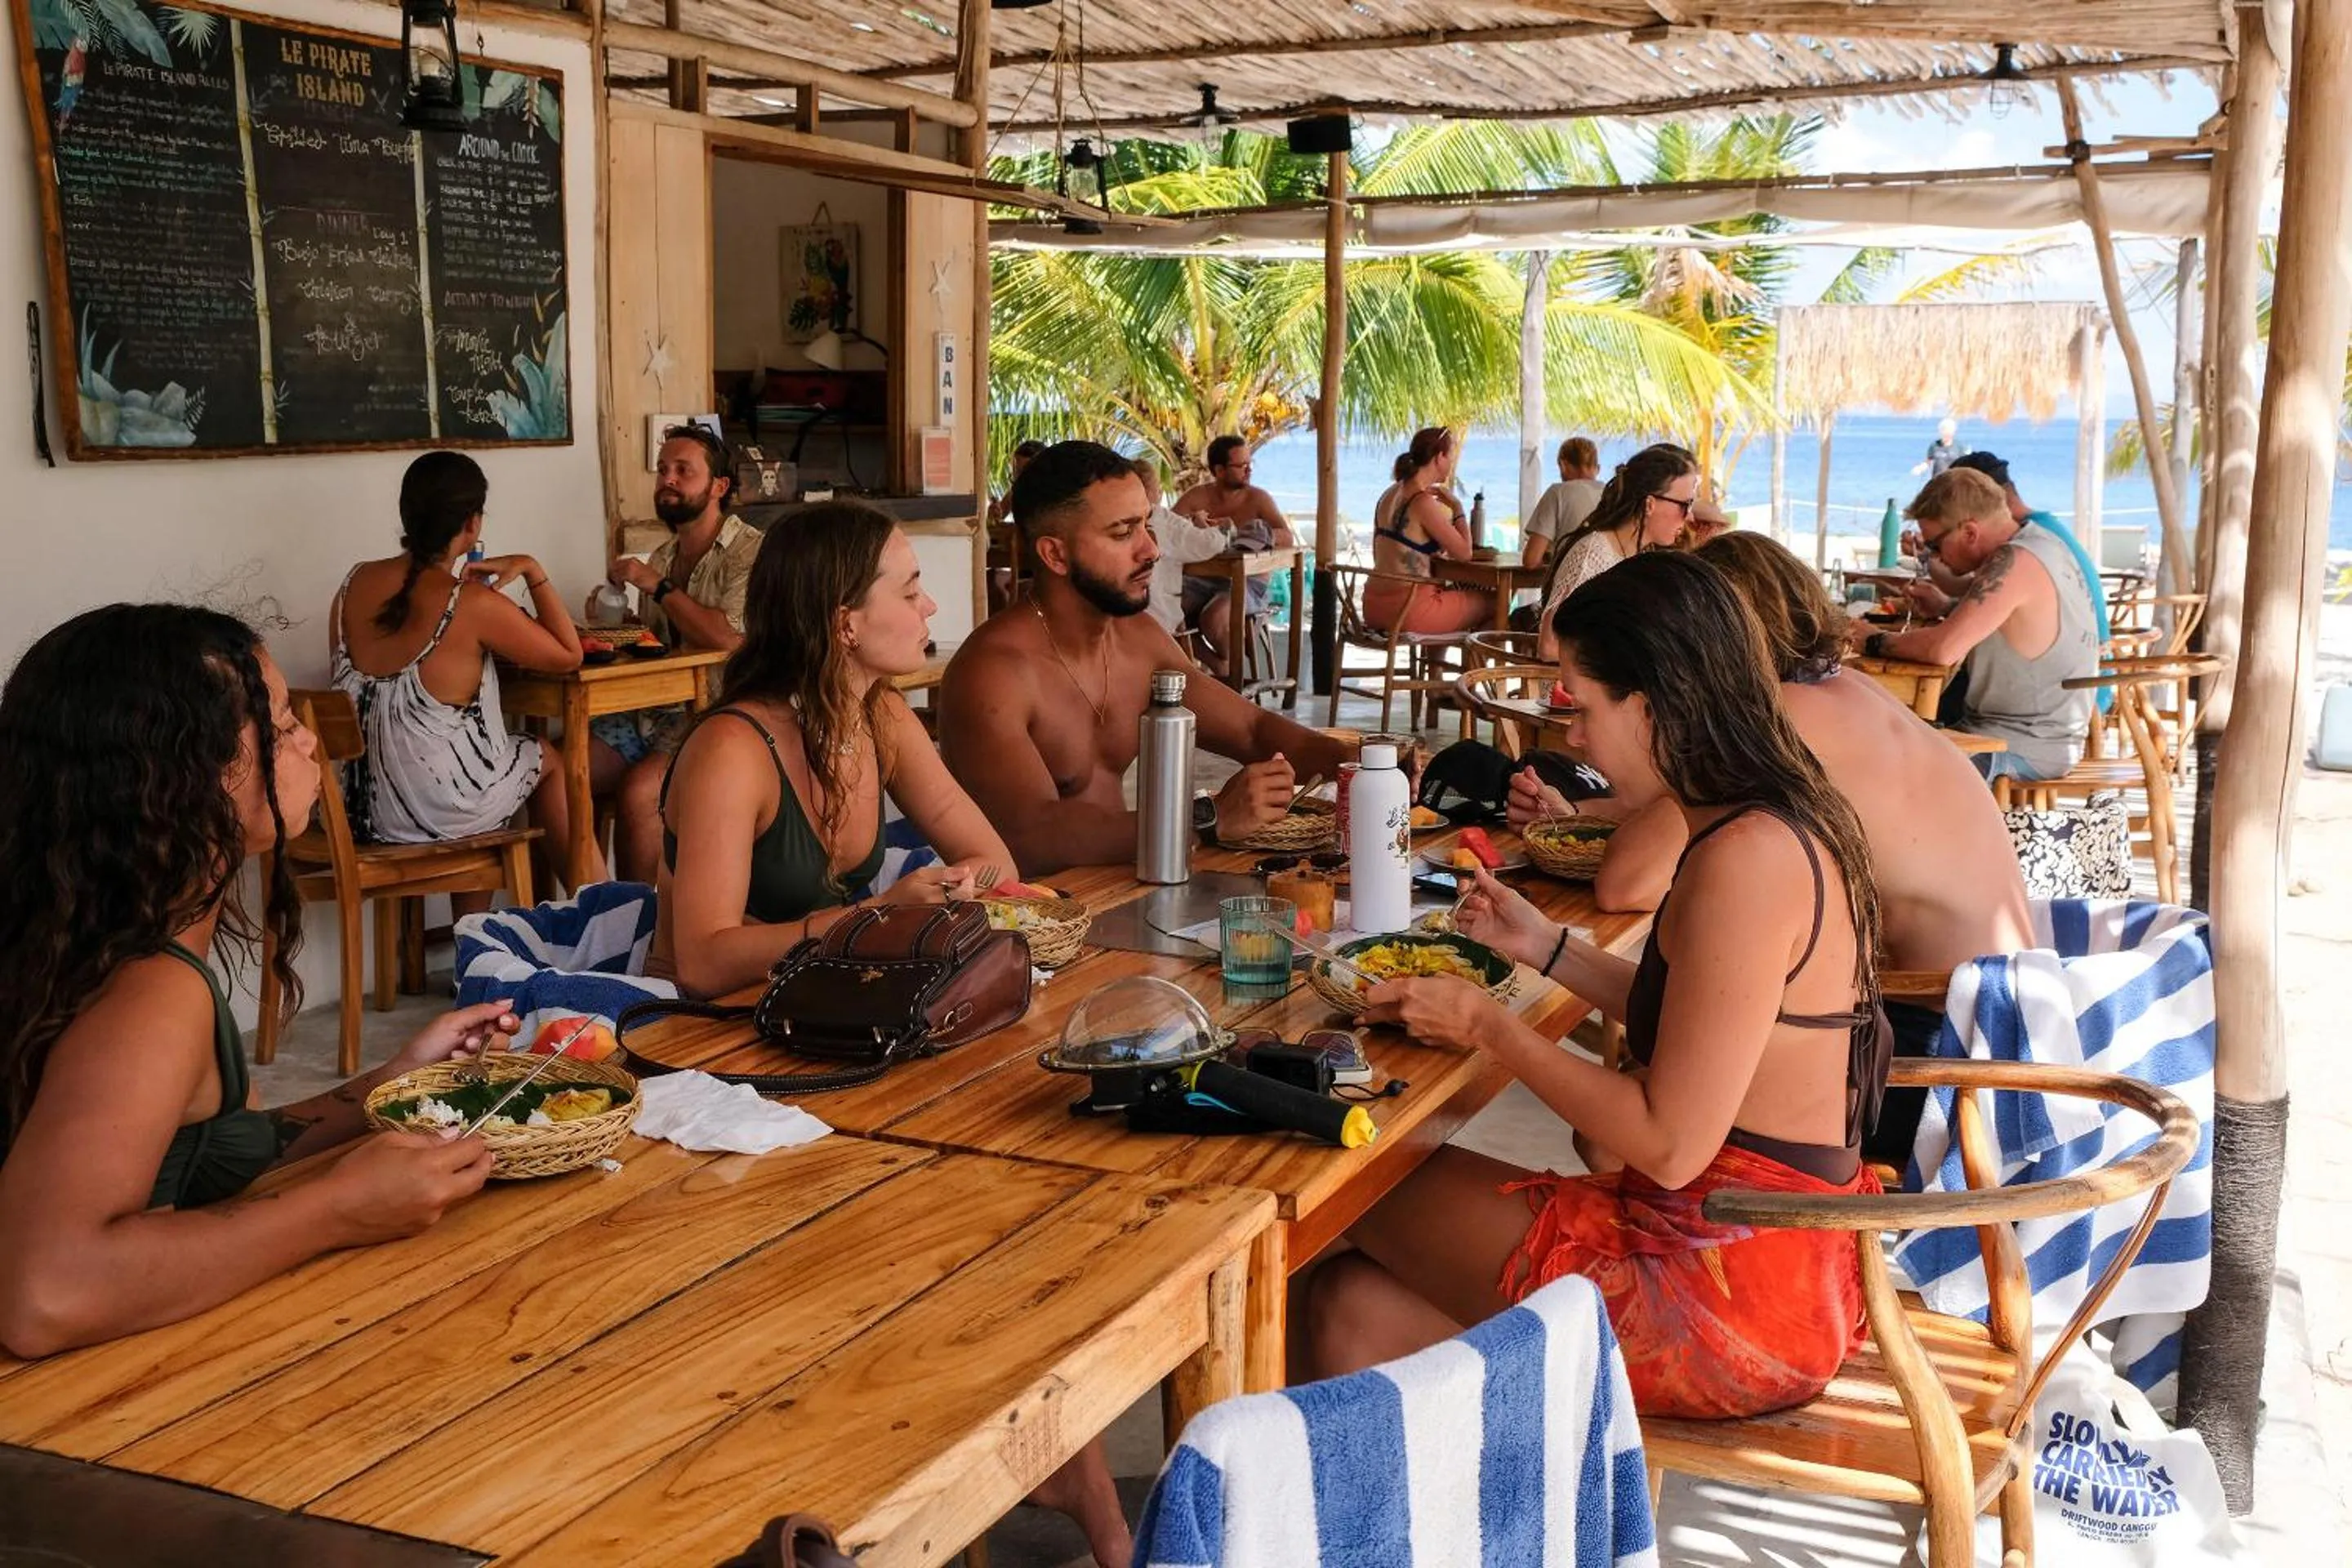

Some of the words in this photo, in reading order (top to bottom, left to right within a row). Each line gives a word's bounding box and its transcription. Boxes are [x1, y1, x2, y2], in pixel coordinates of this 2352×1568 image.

[280, 38, 303, 65] LE
[310, 42, 372, 78] PIRATE
[115, 63, 155, 81] PIRATE
[160, 71, 196, 86] ISLAND
[296, 73, 365, 107] ISLAND
[458, 133, 500, 159] AROUND
[512, 141, 540, 163] CLOCK
[2034, 1464, 2082, 1505] THE
[2091, 1484, 2180, 1517] WATER
[2061, 1508, 2118, 1531] DRIFTWOOD
